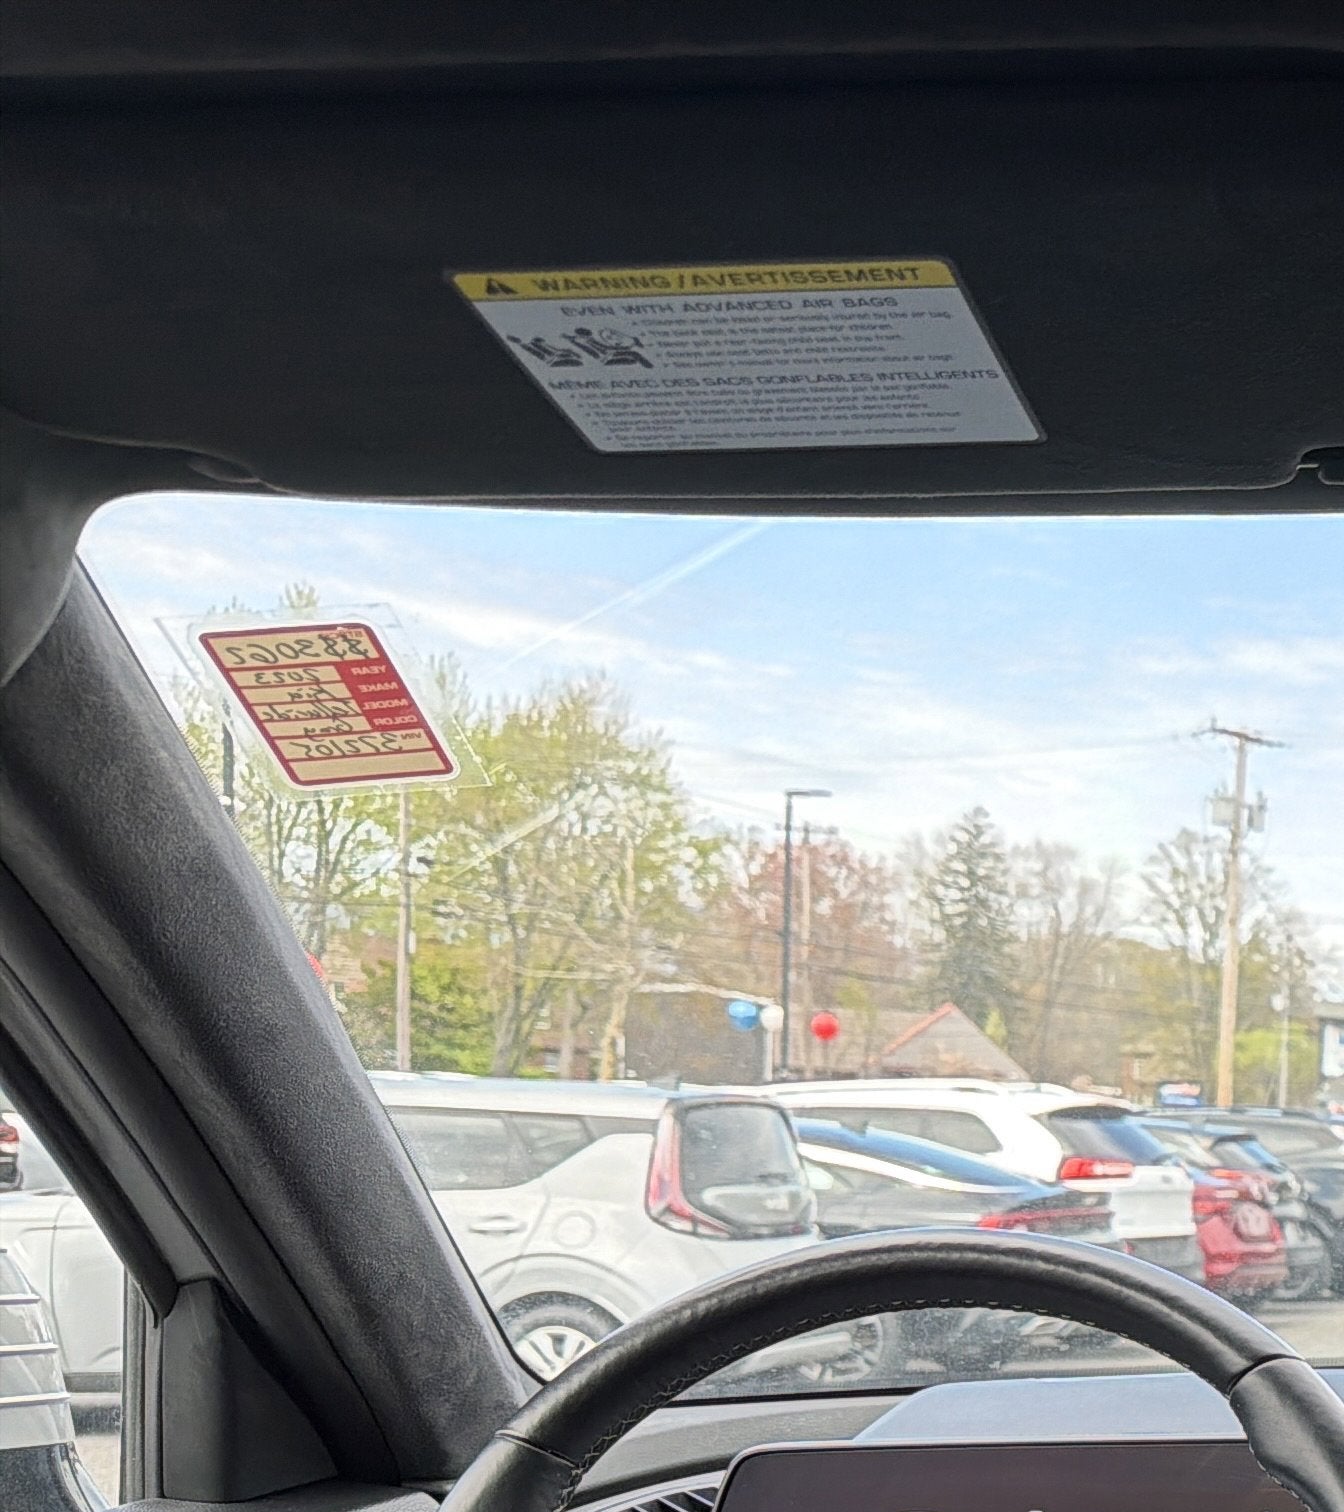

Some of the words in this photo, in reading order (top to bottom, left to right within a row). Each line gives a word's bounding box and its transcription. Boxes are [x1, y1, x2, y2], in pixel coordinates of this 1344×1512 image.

[560, 304, 616, 317] EVEN
[623, 303, 675, 315] WITH
[683, 300, 792, 314] ADVANCED
[802, 298, 835, 310] AIR
[842, 296, 899, 309] BAGS
[611, 377, 659, 389] AVEC
[662, 377, 700, 388] DES
[703, 375, 753, 387] SACS
[756, 372, 874, 386] GONFLABLES
[876, 368, 1000, 381] INTELLIGENTS
